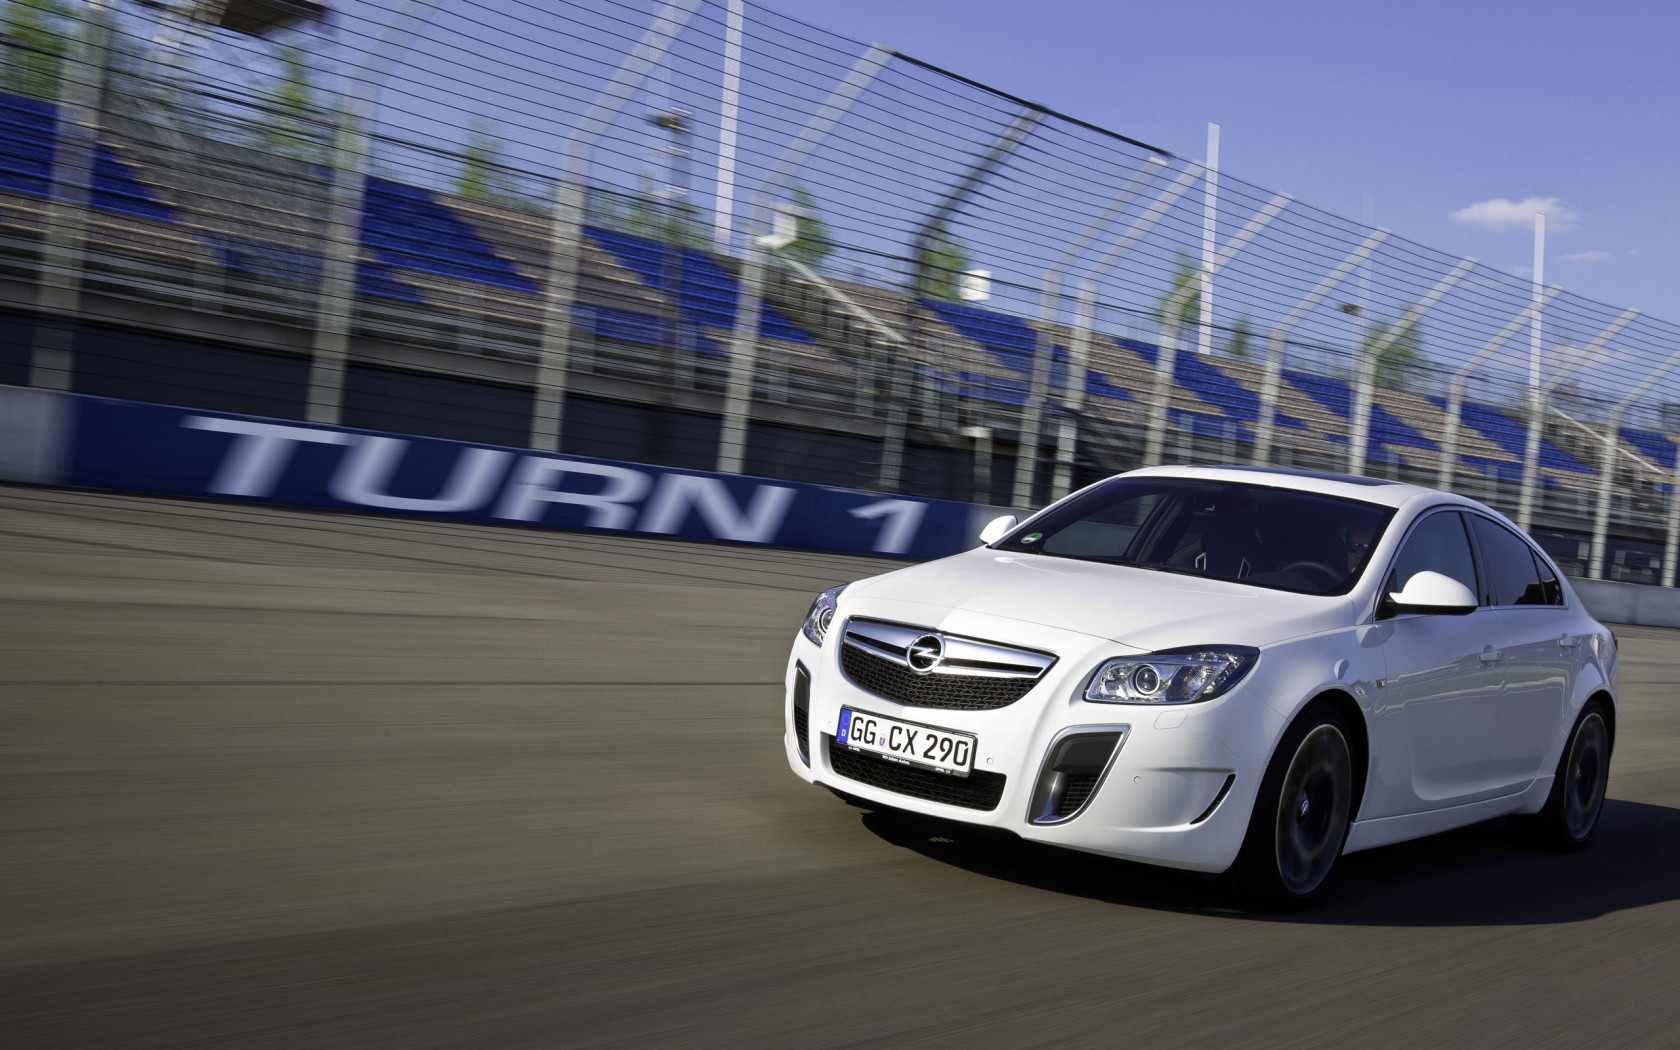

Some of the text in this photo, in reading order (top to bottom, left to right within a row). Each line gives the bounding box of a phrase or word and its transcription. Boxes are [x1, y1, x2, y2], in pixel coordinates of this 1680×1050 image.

[180, 415, 929, 554] TURN 1
[841, 729, 847, 737] D
[851, 716, 969, 766] GG CX 290
